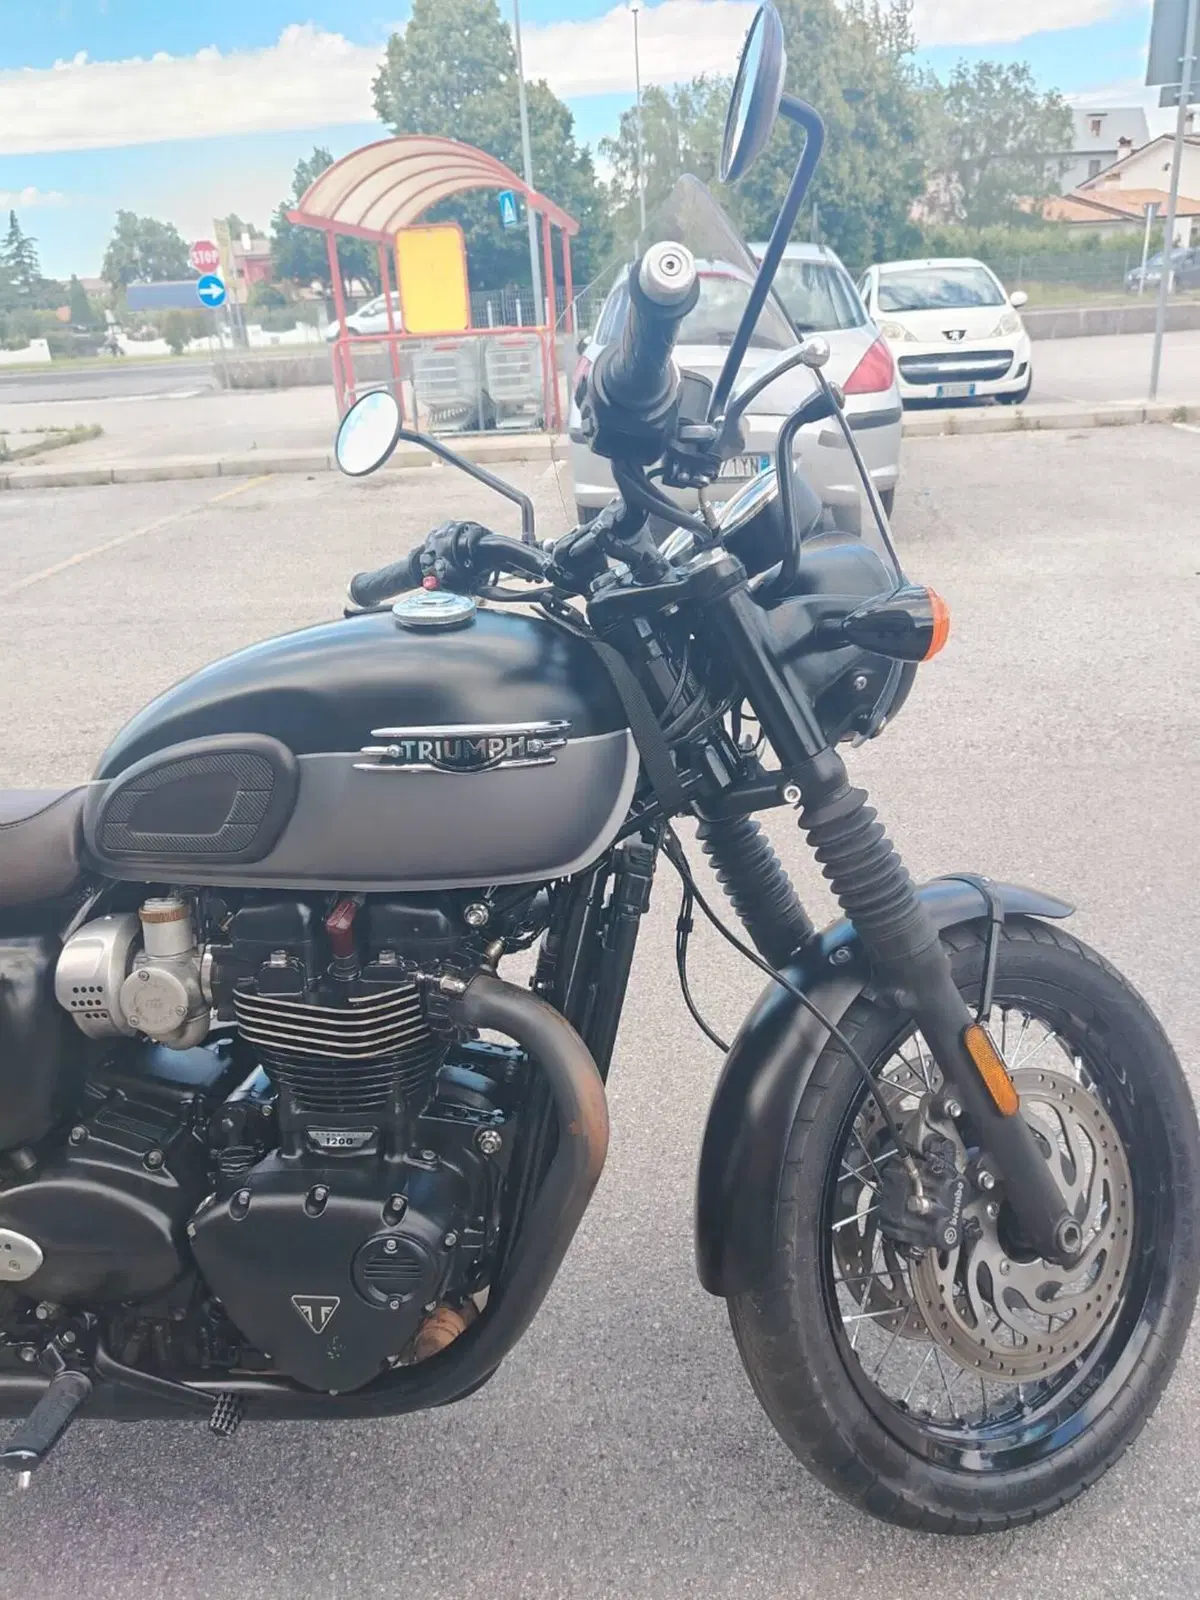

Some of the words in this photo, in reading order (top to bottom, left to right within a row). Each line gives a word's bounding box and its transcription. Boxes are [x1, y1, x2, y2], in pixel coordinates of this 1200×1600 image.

[192, 249, 220, 264] STOP
[401, 736, 526, 761] TRIUMPH
[326, 1137, 354, 1145] 1200
[949, 1181, 964, 1226] brembo
